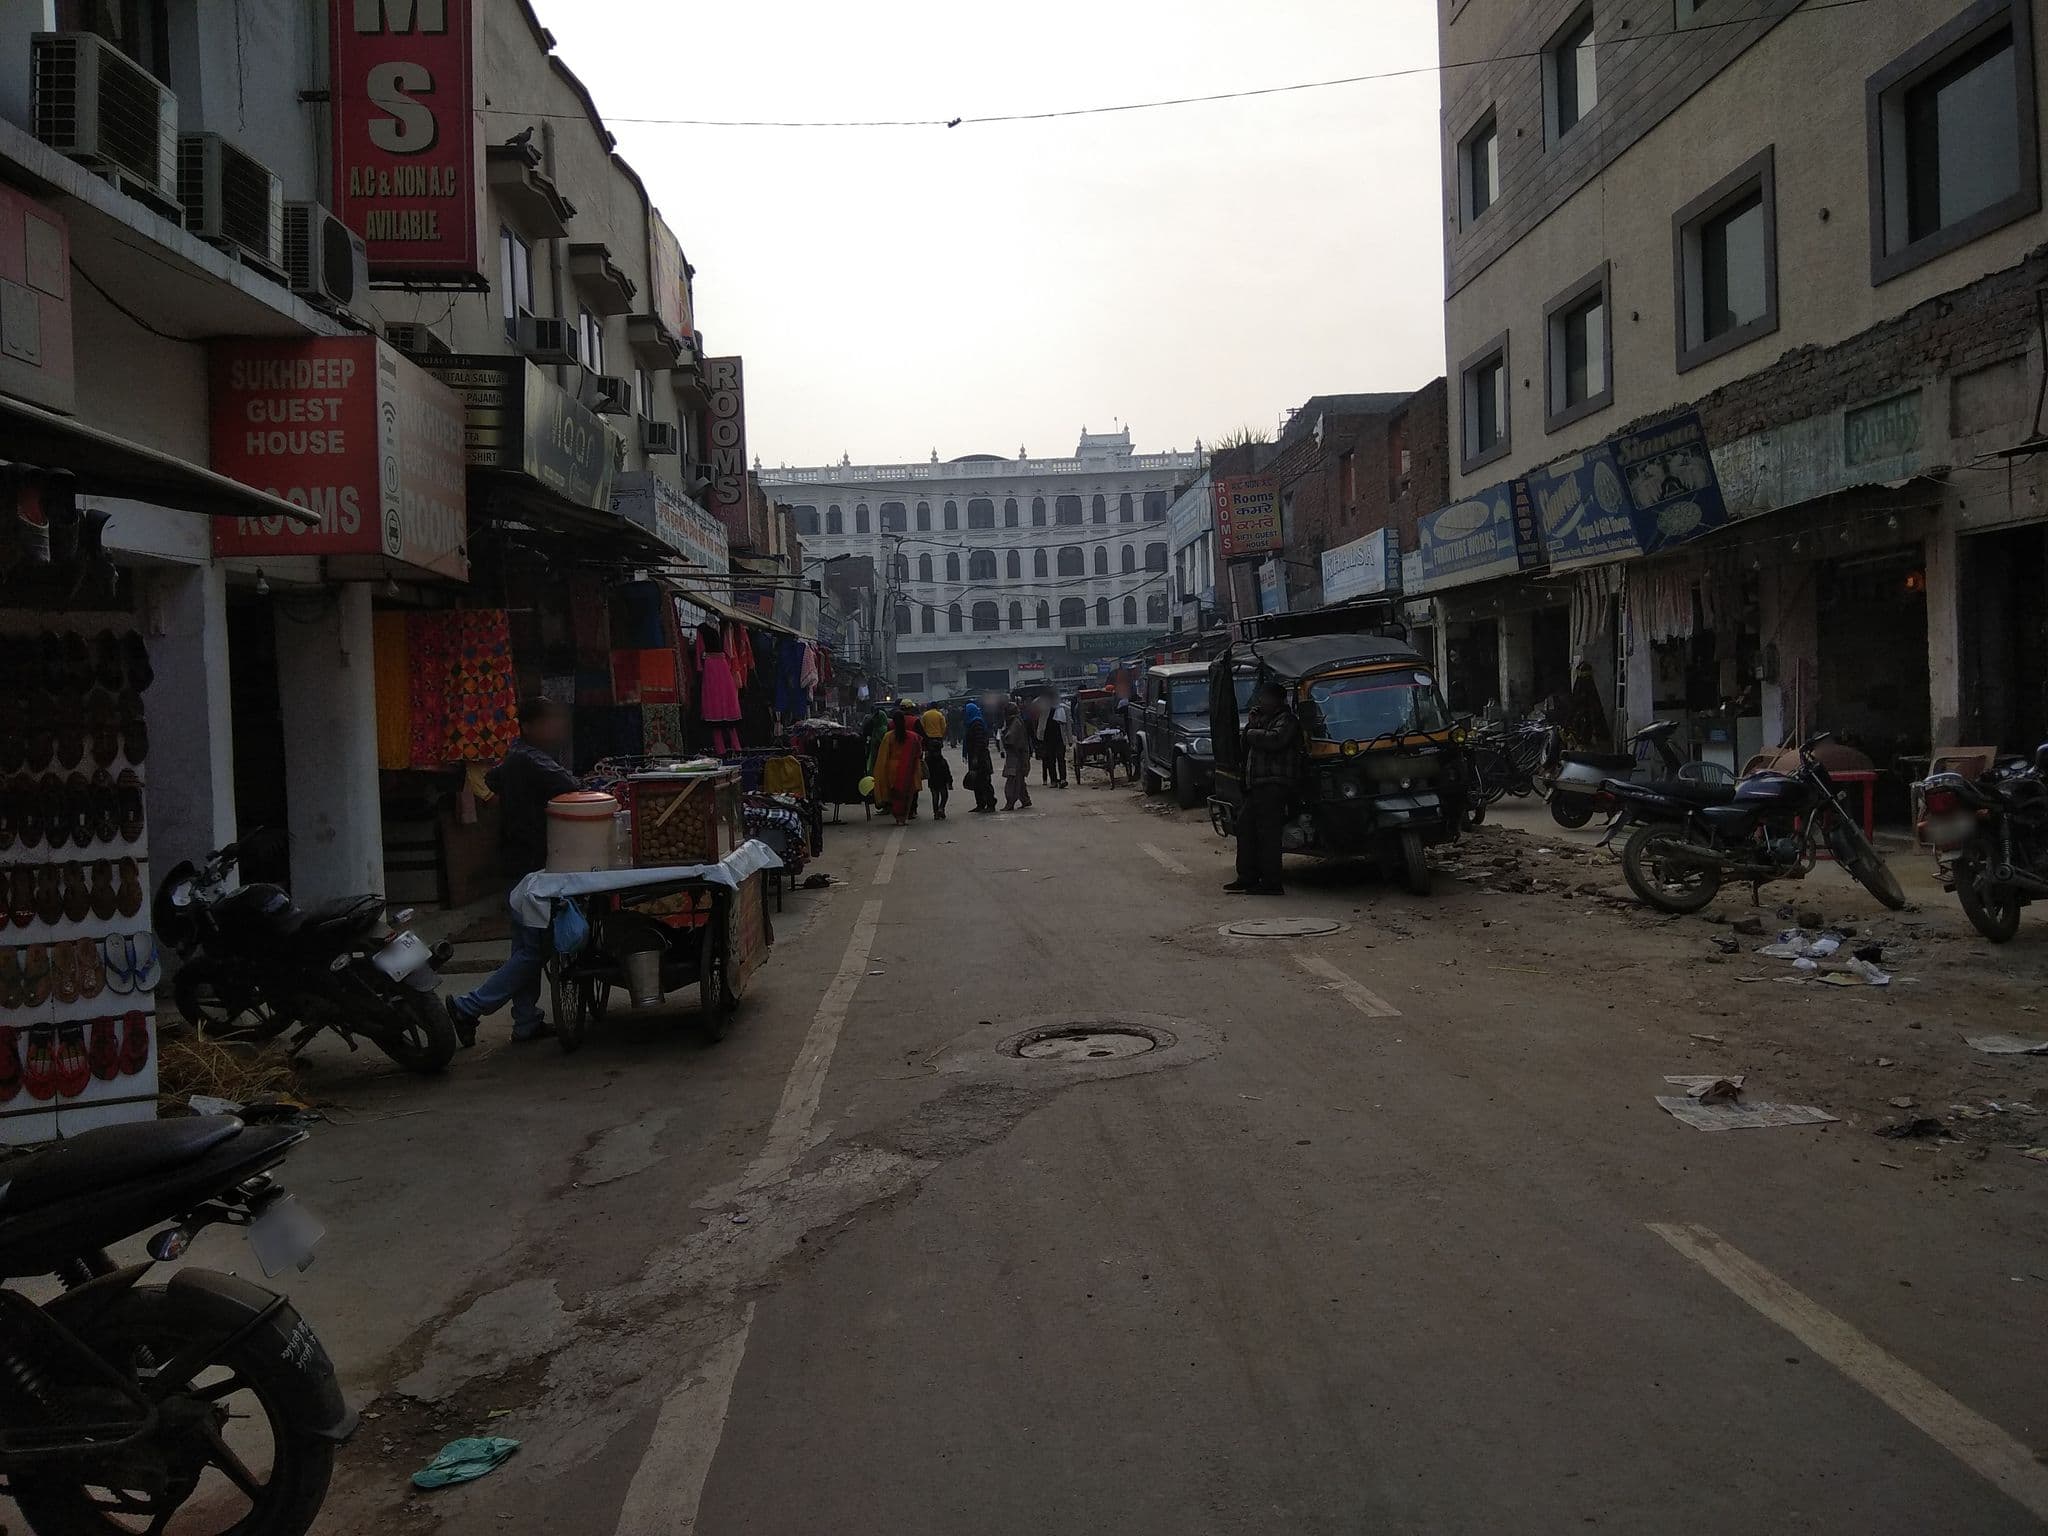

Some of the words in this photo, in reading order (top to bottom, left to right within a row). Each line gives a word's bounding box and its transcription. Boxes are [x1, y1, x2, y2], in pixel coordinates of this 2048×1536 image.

[379, 171, 391, 196] &
[394, 166, 427, 196] NON
[232, 358, 355, 390] SUKHDEEP
[247, 398, 343, 423] GUEST
[467, 392, 503, 404] PAJAMA
[246, 430, 345, 456] HOUSE
[711, 362, 743, 504] ROOMS
[1233, 492, 1274, 504] Rooms
[1218, 482, 1232, 549] ROOMS
